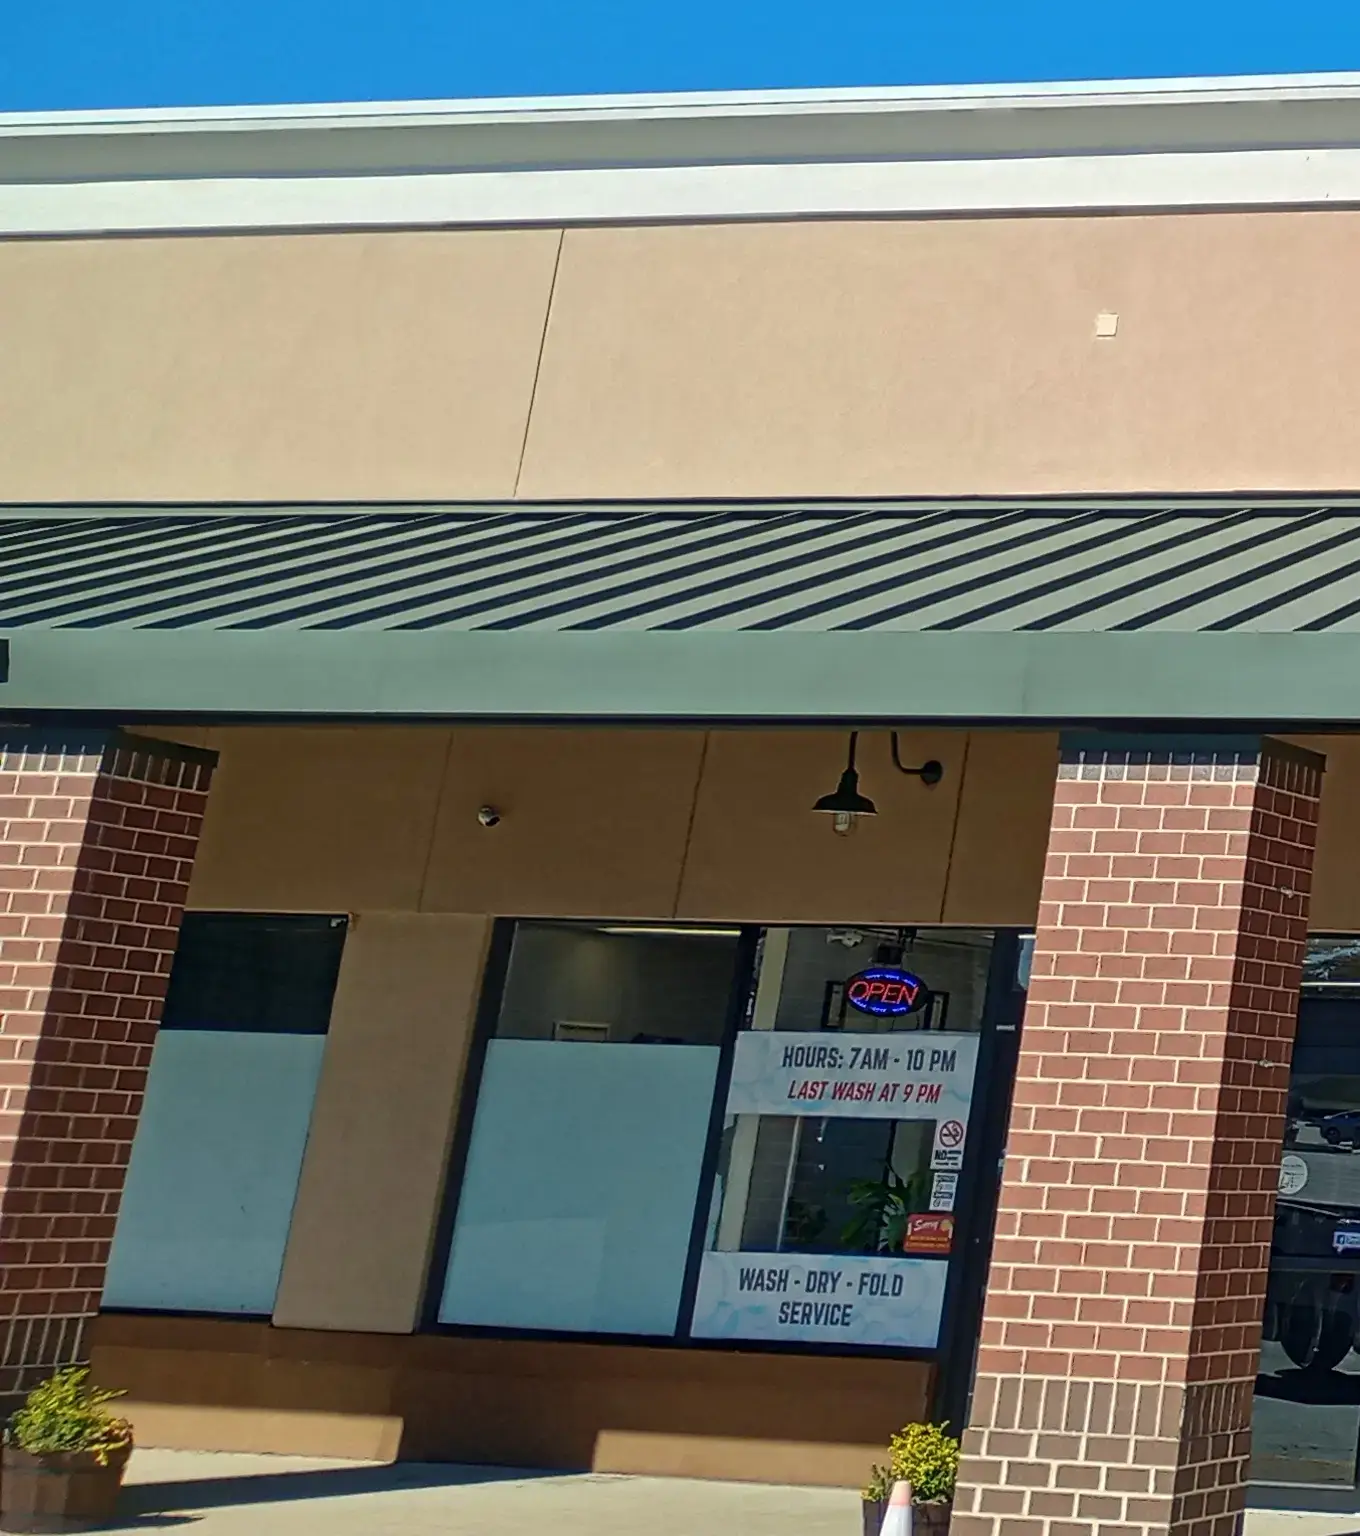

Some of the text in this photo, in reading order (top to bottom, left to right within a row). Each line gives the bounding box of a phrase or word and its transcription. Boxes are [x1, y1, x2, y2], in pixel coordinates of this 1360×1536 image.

[848, 981, 919, 1006] OPEN
[782, 1046, 843, 1069] HOURS:
[850, 1047, 889, 1070] 7AM
[906, 1049, 926, 1071] 10
[929, 1050, 957, 1072] PM
[787, 1080, 942, 1104] LAST WASH AT 9 PM
[739, 1268, 789, 1292] WASH
[805, 1270, 842, 1294] DRY
[857, 1272, 903, 1296] FOLD
[778, 1301, 853, 1326] SERVICE
